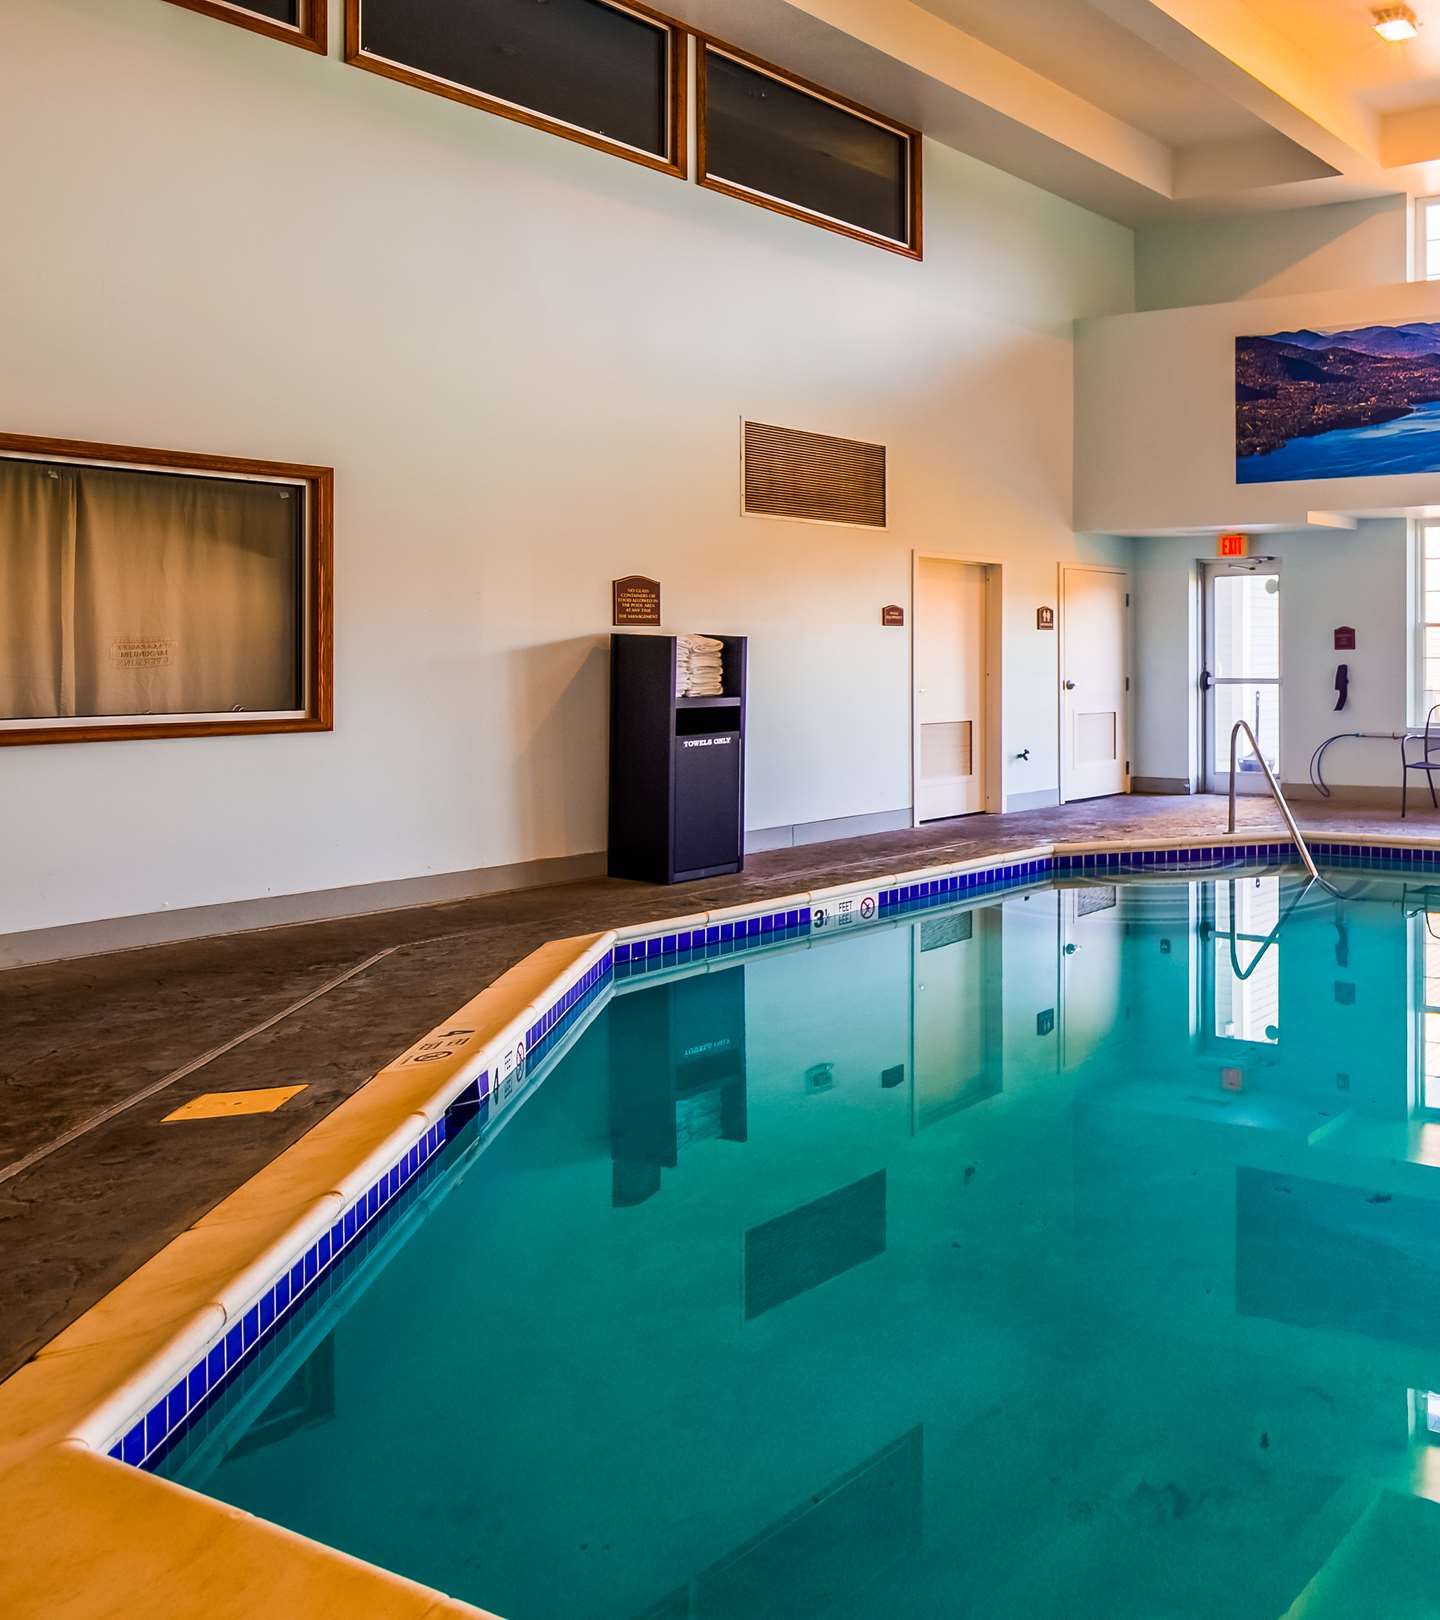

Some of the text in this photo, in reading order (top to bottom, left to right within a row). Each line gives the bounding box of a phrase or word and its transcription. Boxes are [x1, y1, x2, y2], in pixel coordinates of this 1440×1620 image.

[1221, 536, 1242, 555] EXIT
[683, 737, 731, 747] TOWELS ONLY
[839, 900, 853, 912] FEET
